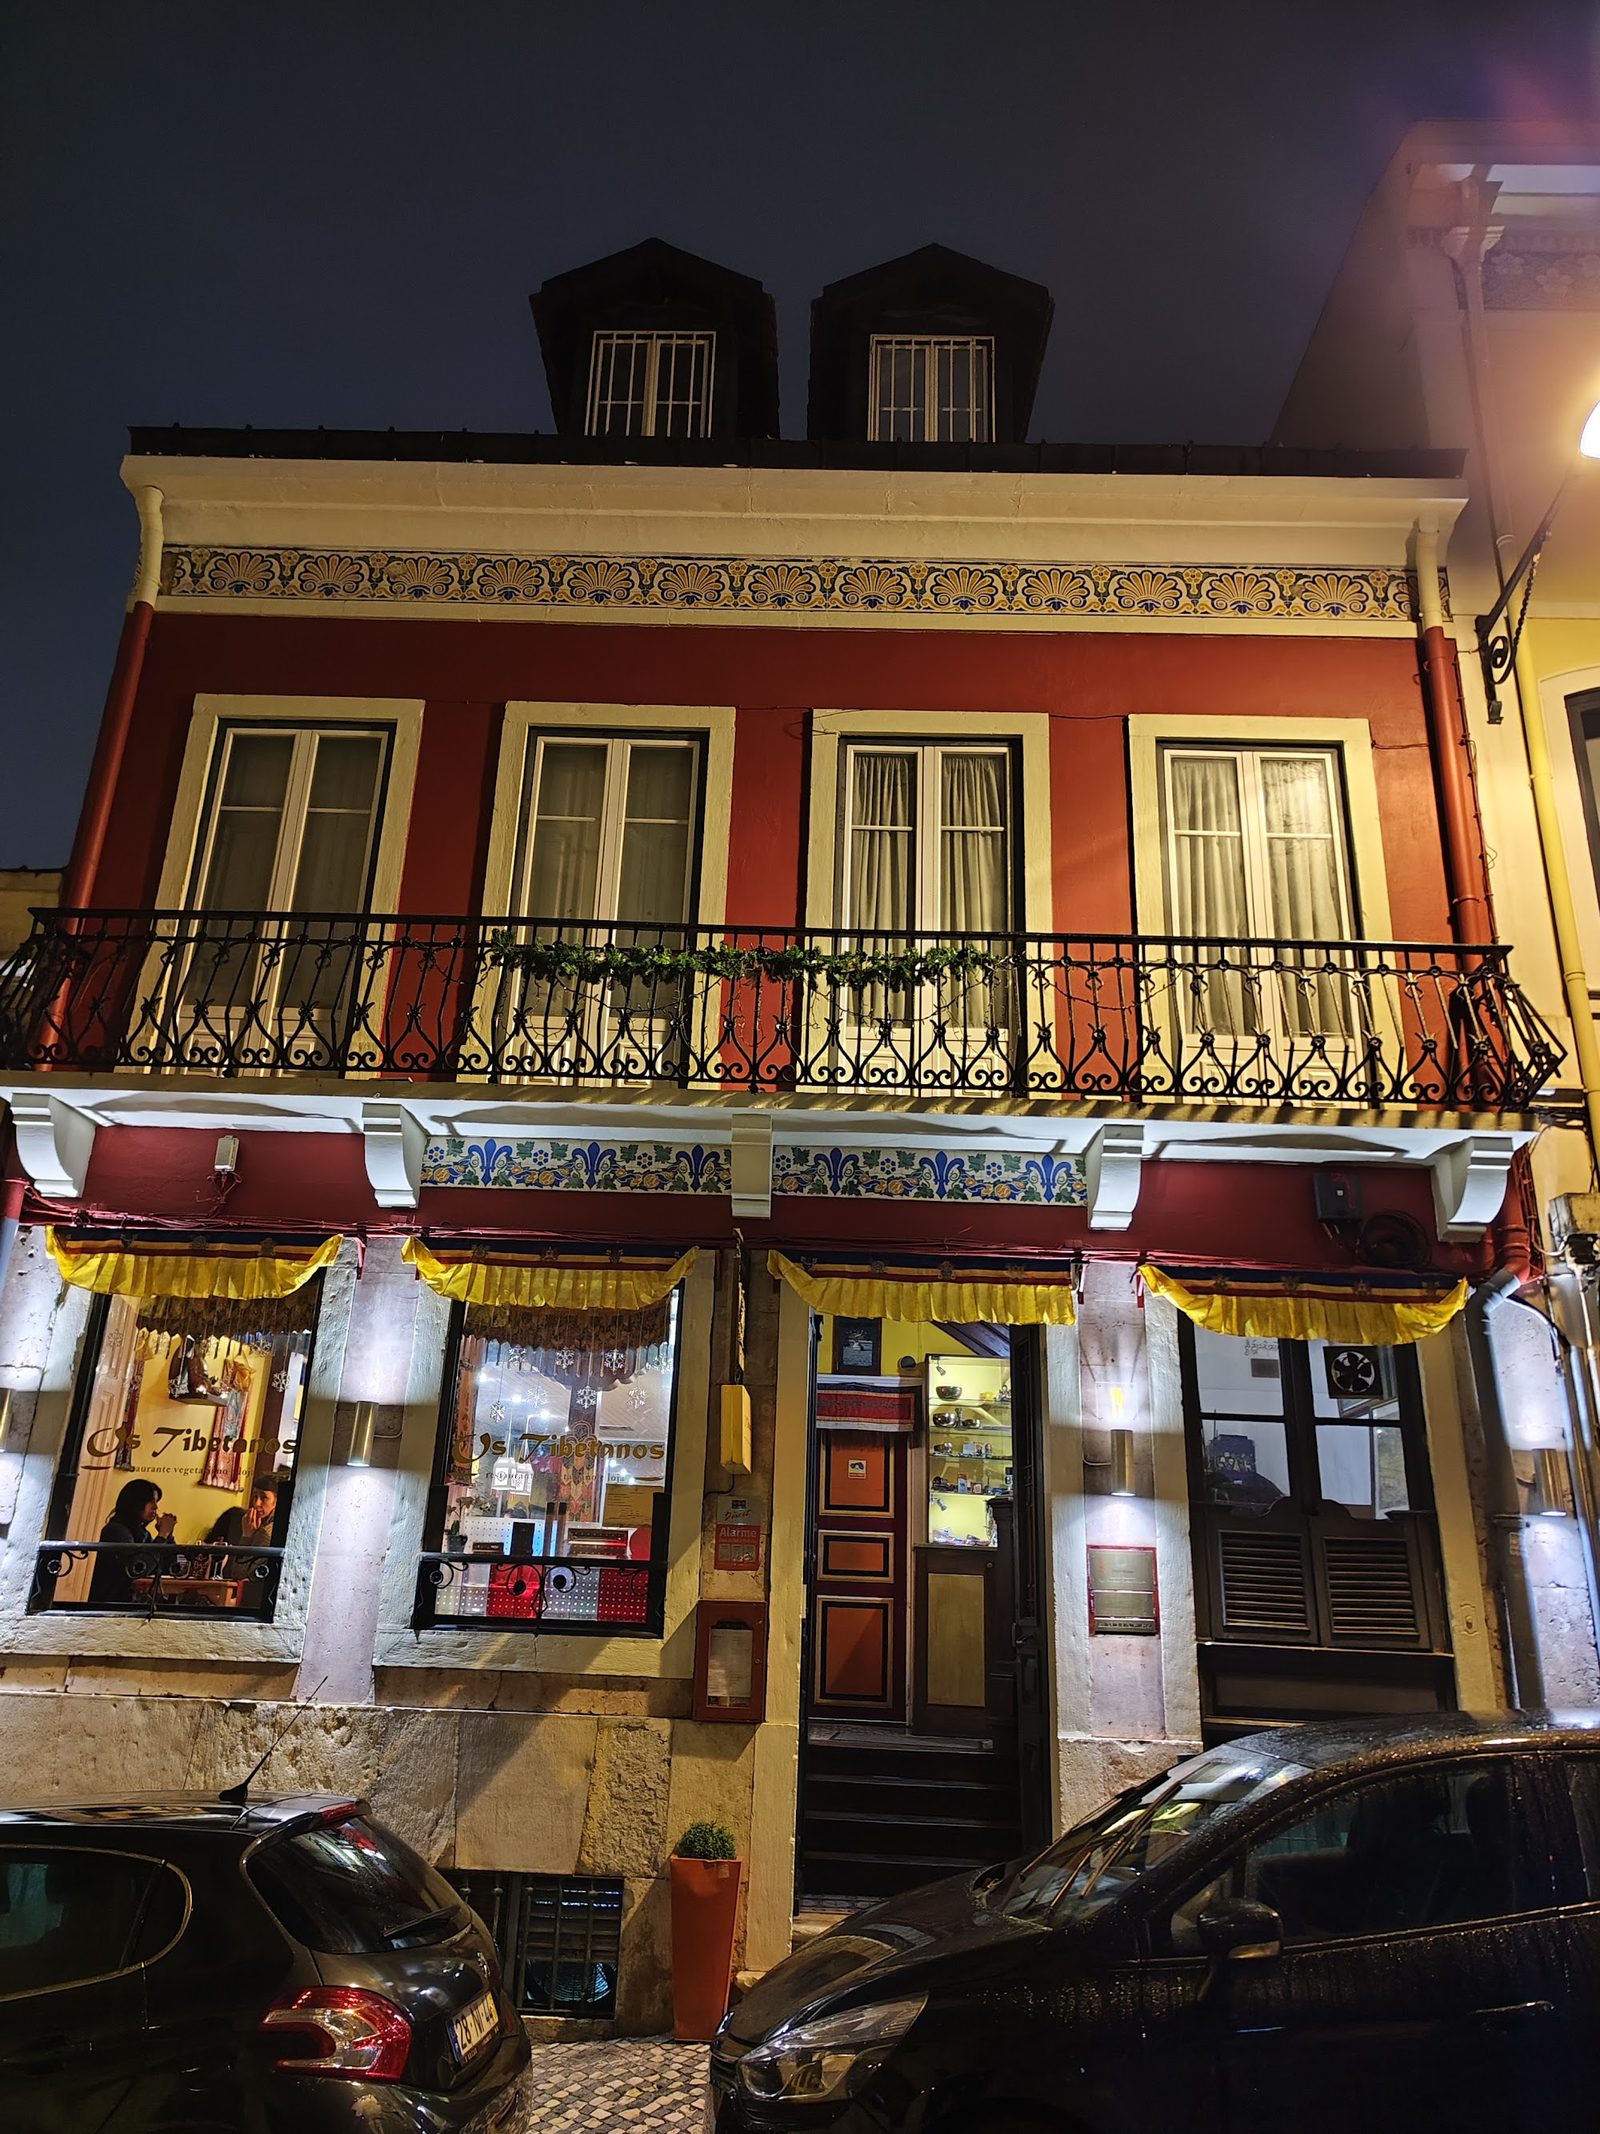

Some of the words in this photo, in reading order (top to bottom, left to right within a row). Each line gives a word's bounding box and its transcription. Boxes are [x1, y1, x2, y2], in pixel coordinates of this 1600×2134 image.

[87, 1425, 141, 1458] Os
[151, 1426, 298, 1458] Tibetanos
[453, 1432, 507, 1464] Os
[518, 1433, 666, 1464] Tibetanos
[719, 1526, 758, 1538] Alarme
